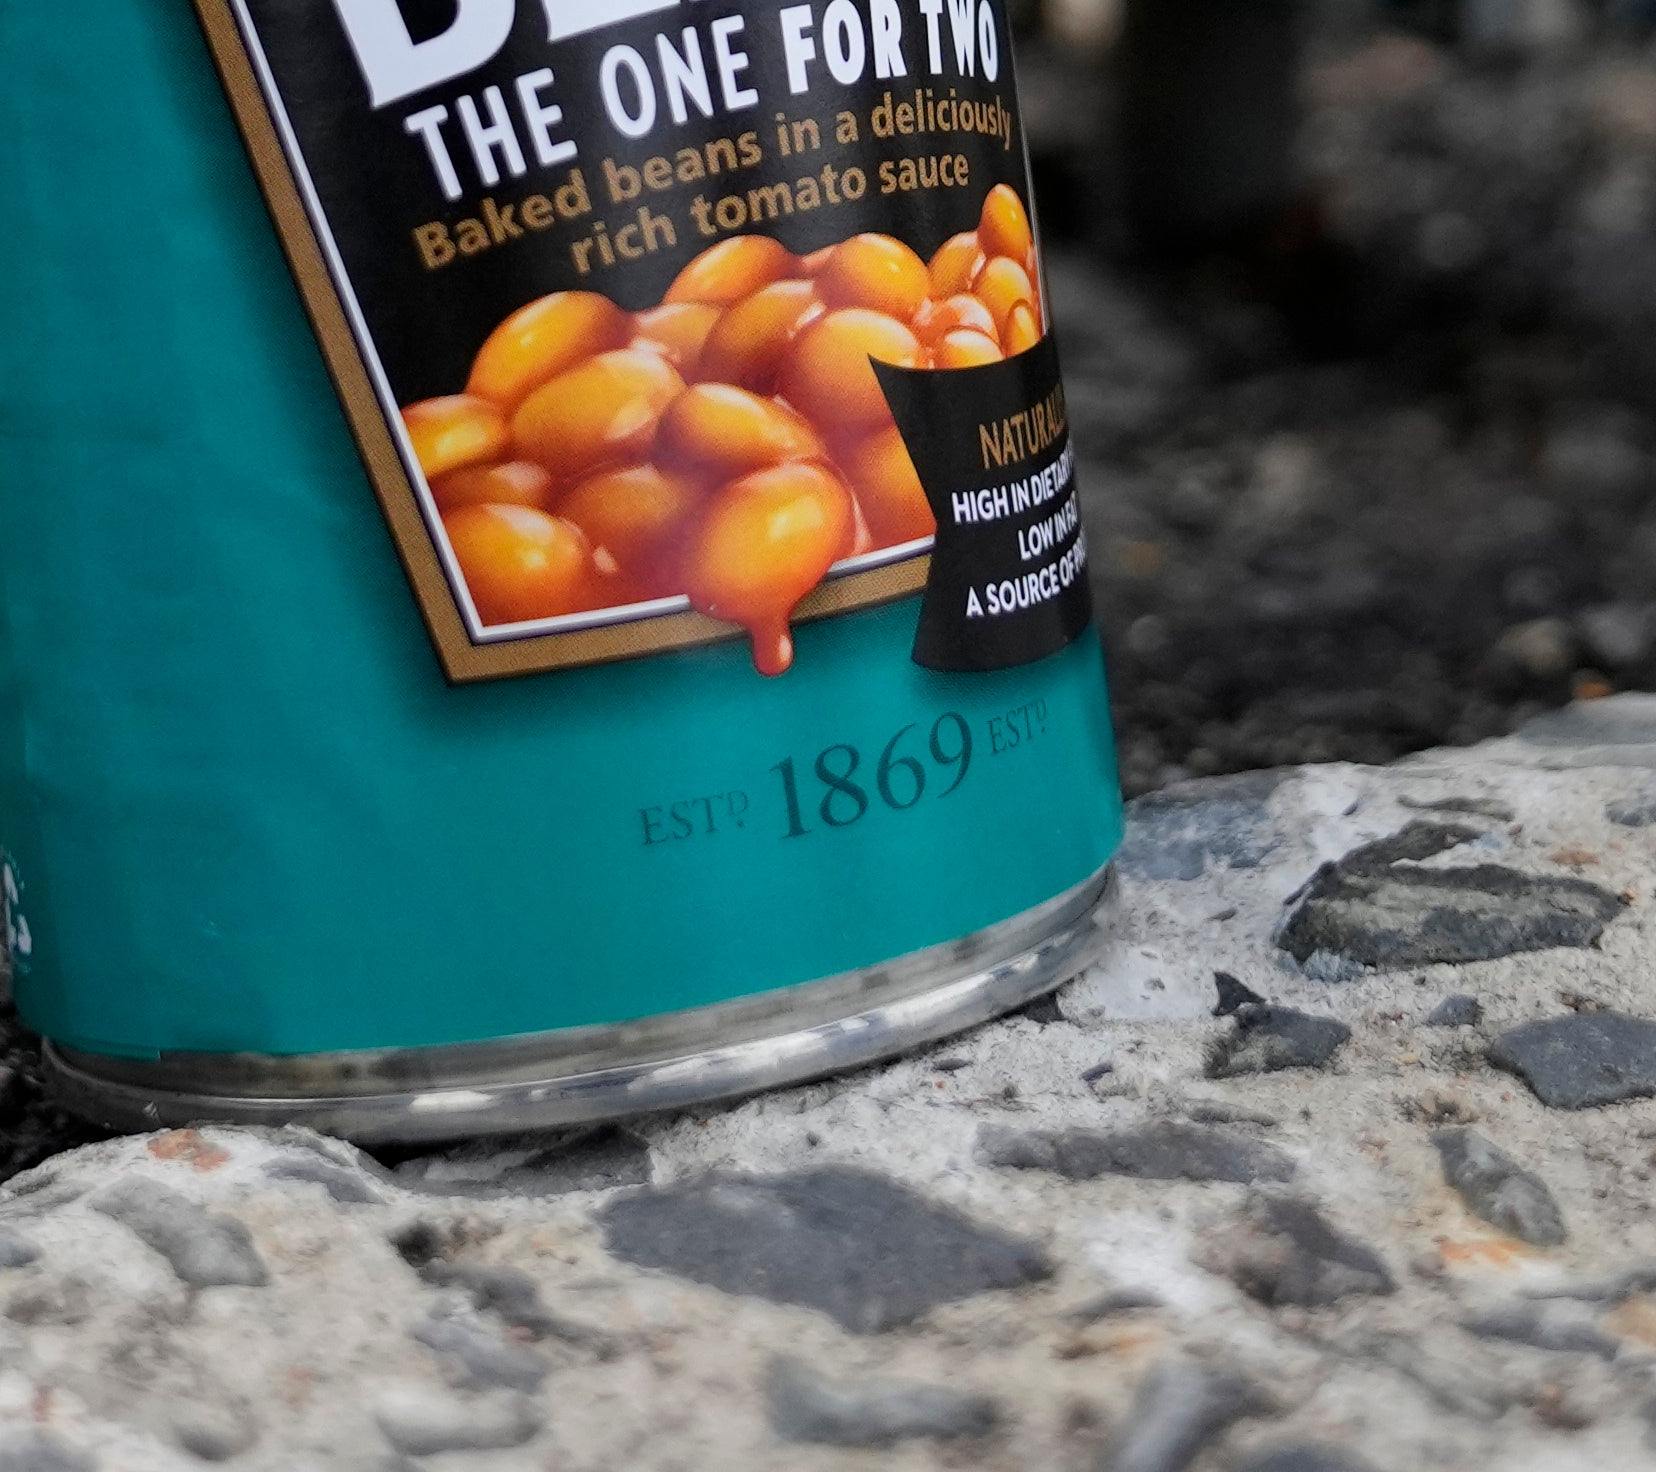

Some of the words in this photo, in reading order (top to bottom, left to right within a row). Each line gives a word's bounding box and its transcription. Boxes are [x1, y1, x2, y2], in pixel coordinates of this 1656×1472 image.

[404, 67, 577, 201] THE
[599, 14, 760, 139] ONE
[411, 168, 592, 271] Baked
[603, 127, 763, 204] beans
[775, 111, 820, 157] in
[835, 110, 861, 145] a
[871, 87, 1012, 152] deliciously
[569, 206, 677, 275] rich
[689, 160, 867, 237] tomato
[879, 153, 970, 195] sauce
[951, 484, 1010, 524] HIGH
[1011, 478, 1030, 514] IN
[1017, 516, 1055, 561] LOW
[1053, 506, 1069, 543] IN
[965, 586, 984, 618] A
[987, 562, 1061, 617] SOURCE
[1059, 548, 1075, 588] OF
[769, 711, 973, 840] 1869
